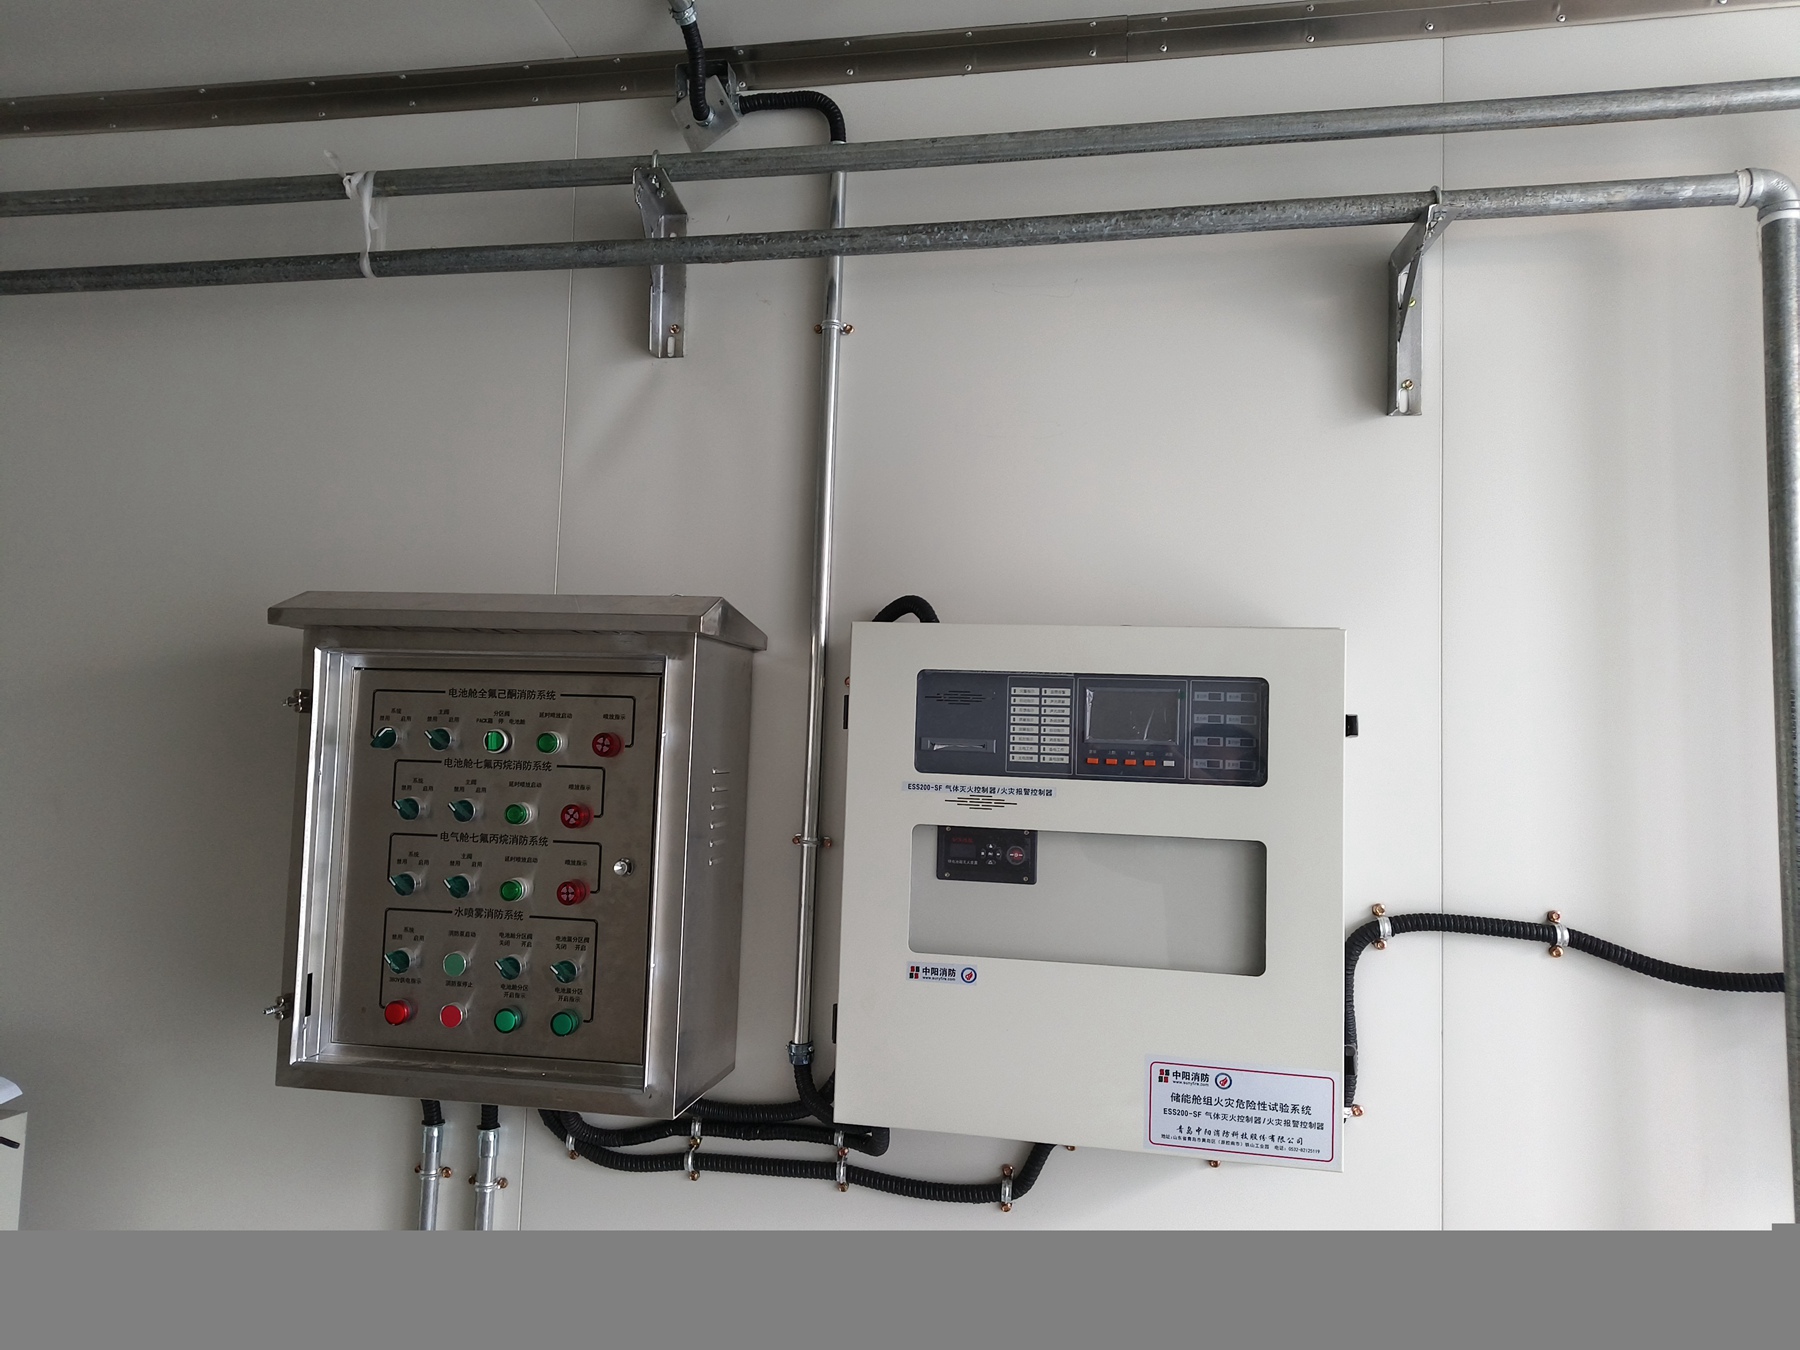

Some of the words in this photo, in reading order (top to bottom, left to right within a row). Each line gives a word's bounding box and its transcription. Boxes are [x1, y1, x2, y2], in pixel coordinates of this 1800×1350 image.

[448, 687, 556, 700] 电池舱全氟己酮消防系统
[443, 758, 552, 772] 电池舱七氟丙烷消防系统
[907, 783, 942, 792] ESS200-SF
[945, 784, 1053, 796] 气体灭火控制器/火灾报警控制器
[440, 830, 549, 847] 电气舱七氟丙烷消防系统
[454, 907, 524, 921] 水喷雾消防系统
[922, 966, 956, 978] 中阳消防
[1172, 1070, 1210, 1083] 中阳消防
[1170, 1092, 1312, 1116] 储能舱组火灾危险性试验系统
[1163, 1108, 1202, 1118] ESS200-SF
[1205, 1112, 1324, 1131] 气体灭火控制器/火灾报警控制器
[1176, 1124, 1304, 1146] 青岛中阳消防科技股份有限公司
